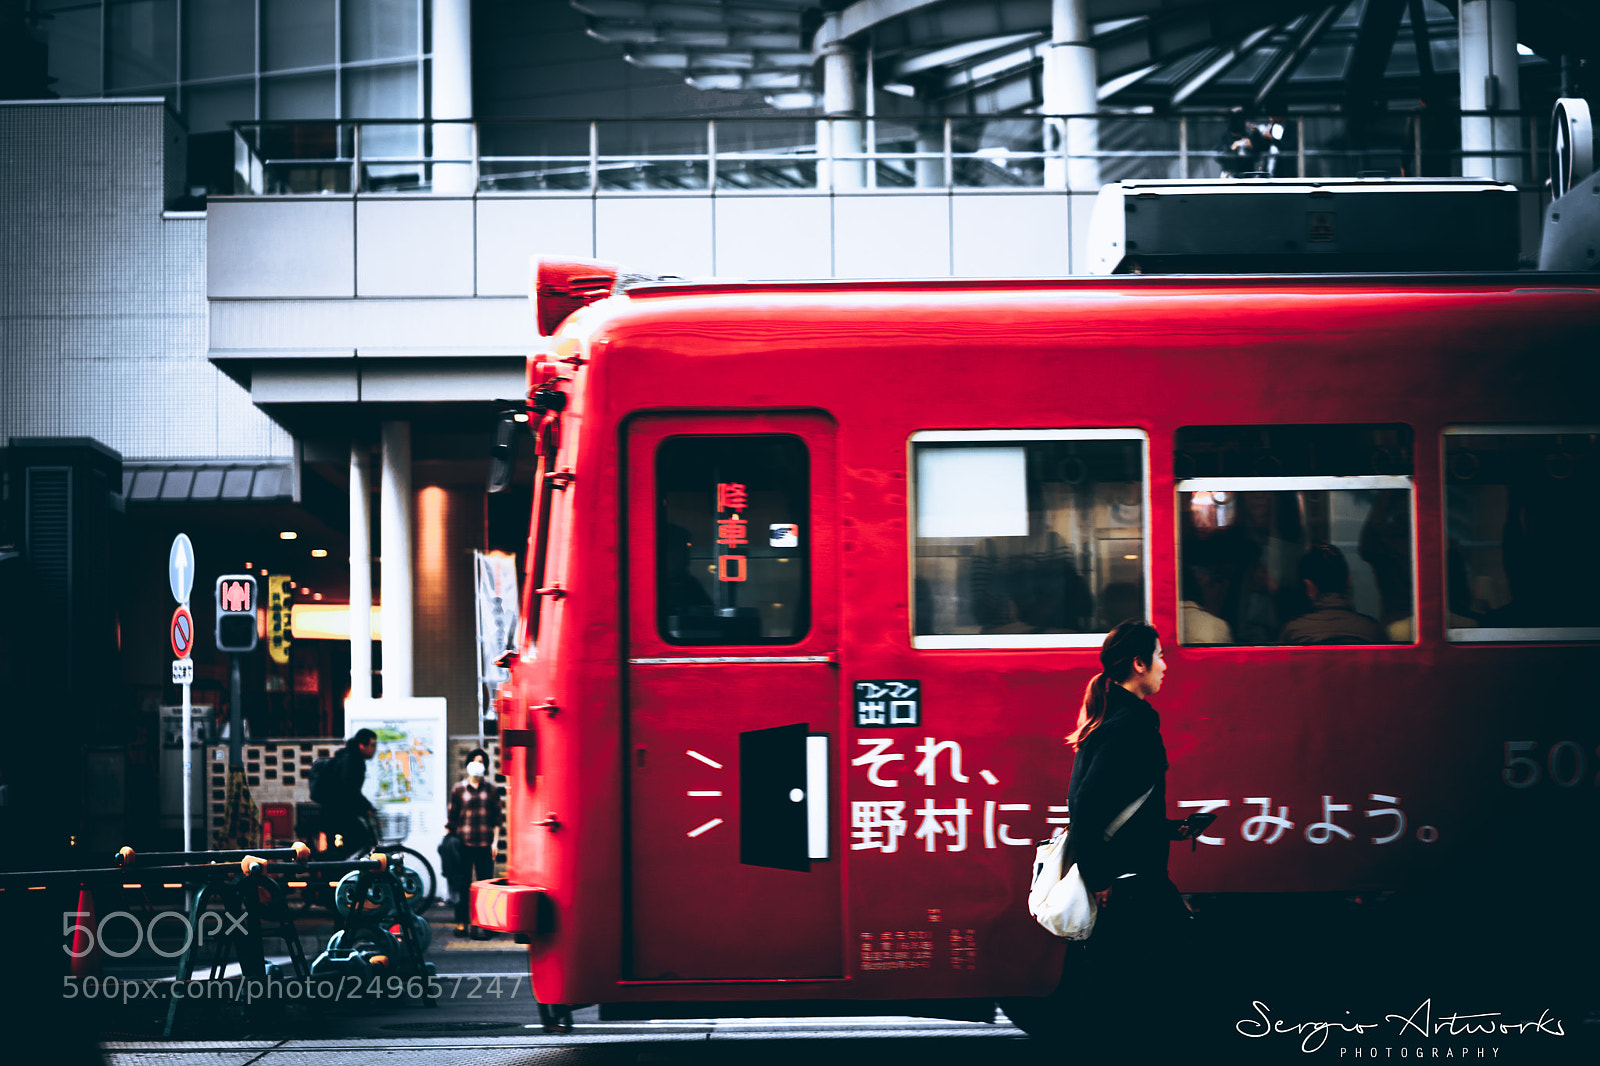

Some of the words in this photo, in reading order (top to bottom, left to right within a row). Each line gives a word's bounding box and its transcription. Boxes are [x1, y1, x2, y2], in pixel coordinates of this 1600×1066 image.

[715, 482, 750, 583] 降車口
[856, 682, 918, 698] ワンマン
[858, 700, 917, 726] 出口
[851, 736, 1000, 789] それ、
[1502, 740, 1600, 789] 50
[850, 793, 1440, 856] 野村にてみよう。
